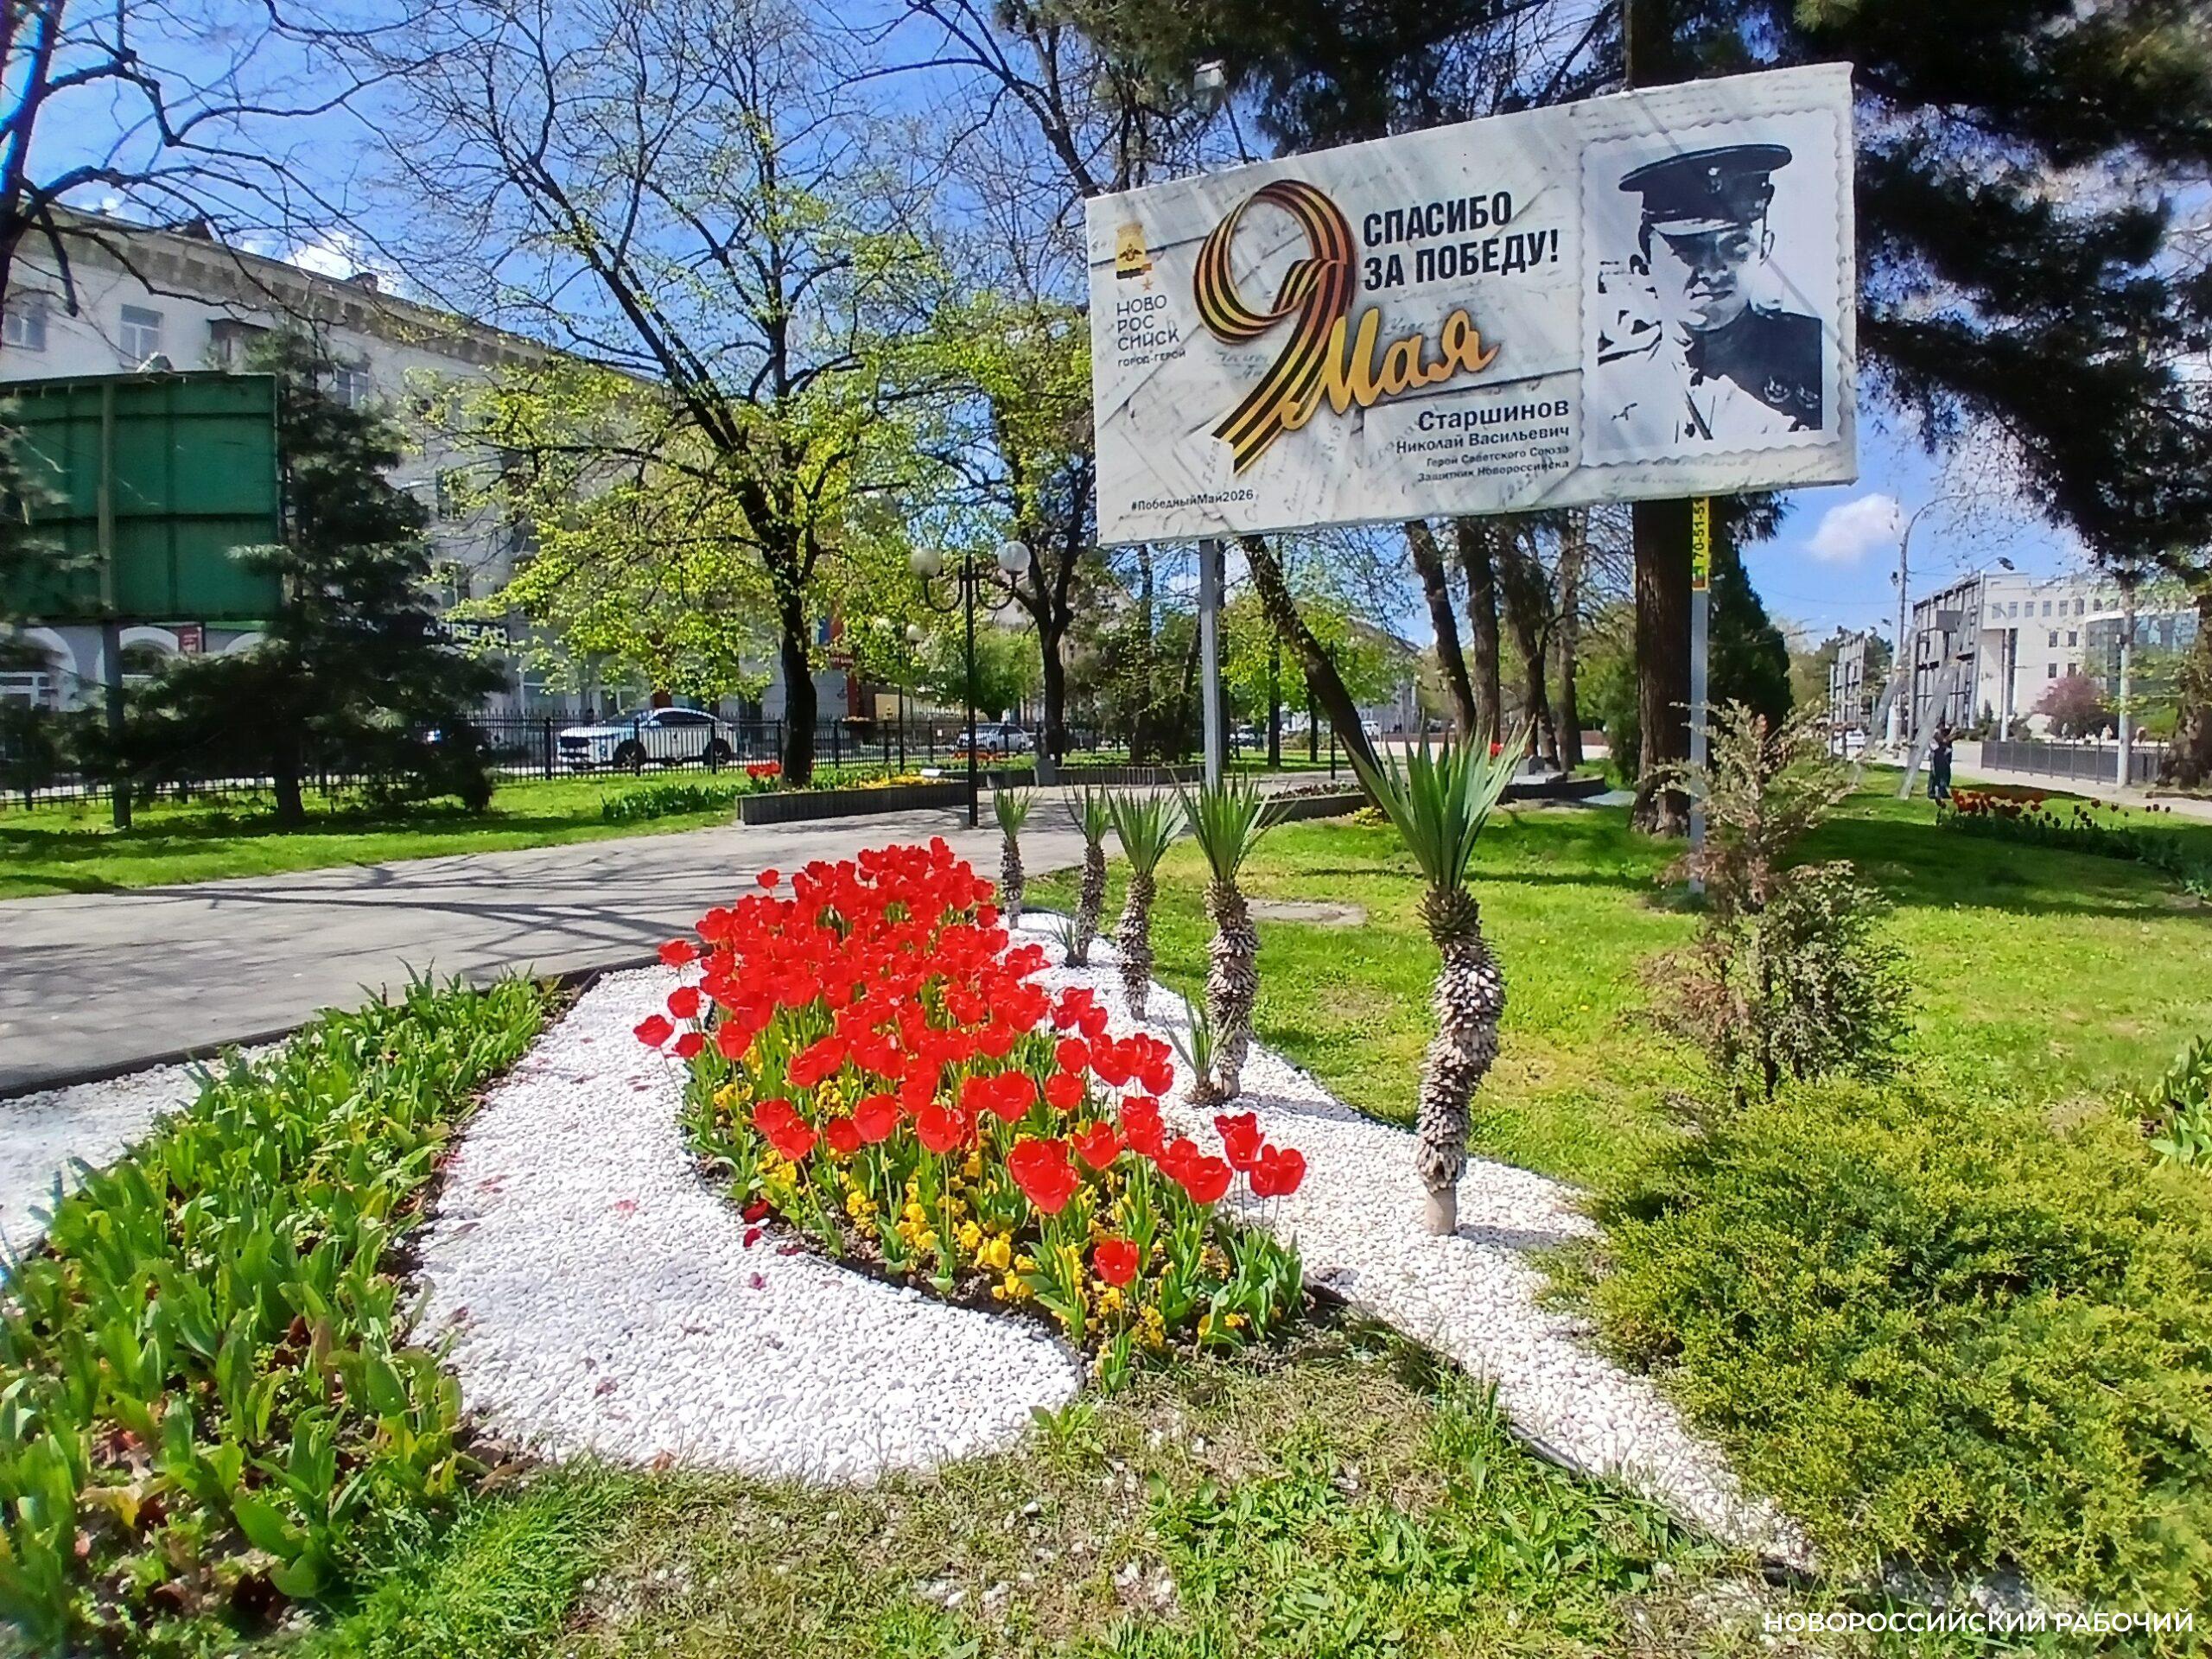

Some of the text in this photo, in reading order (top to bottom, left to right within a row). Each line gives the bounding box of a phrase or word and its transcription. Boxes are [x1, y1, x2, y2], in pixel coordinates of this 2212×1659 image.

[1363, 191, 1512, 247] СПАСИБО
[1363, 228, 1559, 290] ЗА ПОБЕДУ!
[1116, 295, 1167, 316] НОВО
[1117, 315, 1154, 334] РОС
[1117, 328, 1180, 351] СИЙСК
[1117, 347, 1186, 367] ГОРОД-ГЕРОЙ
[1281, 308, 1502, 430] Мая
[1418, 400, 1569, 431] Старшинов
[1396, 426, 1569, 454] Николай Васильевич
[1427, 444, 1569, 467] Герой Советского Союза
[1417, 461, 1569, 483] Защитник Новороссийска
[1131, 489, 1254, 512] #ПобедныйМай2026
[1694, 497, 1706, 560] 70-51-51
